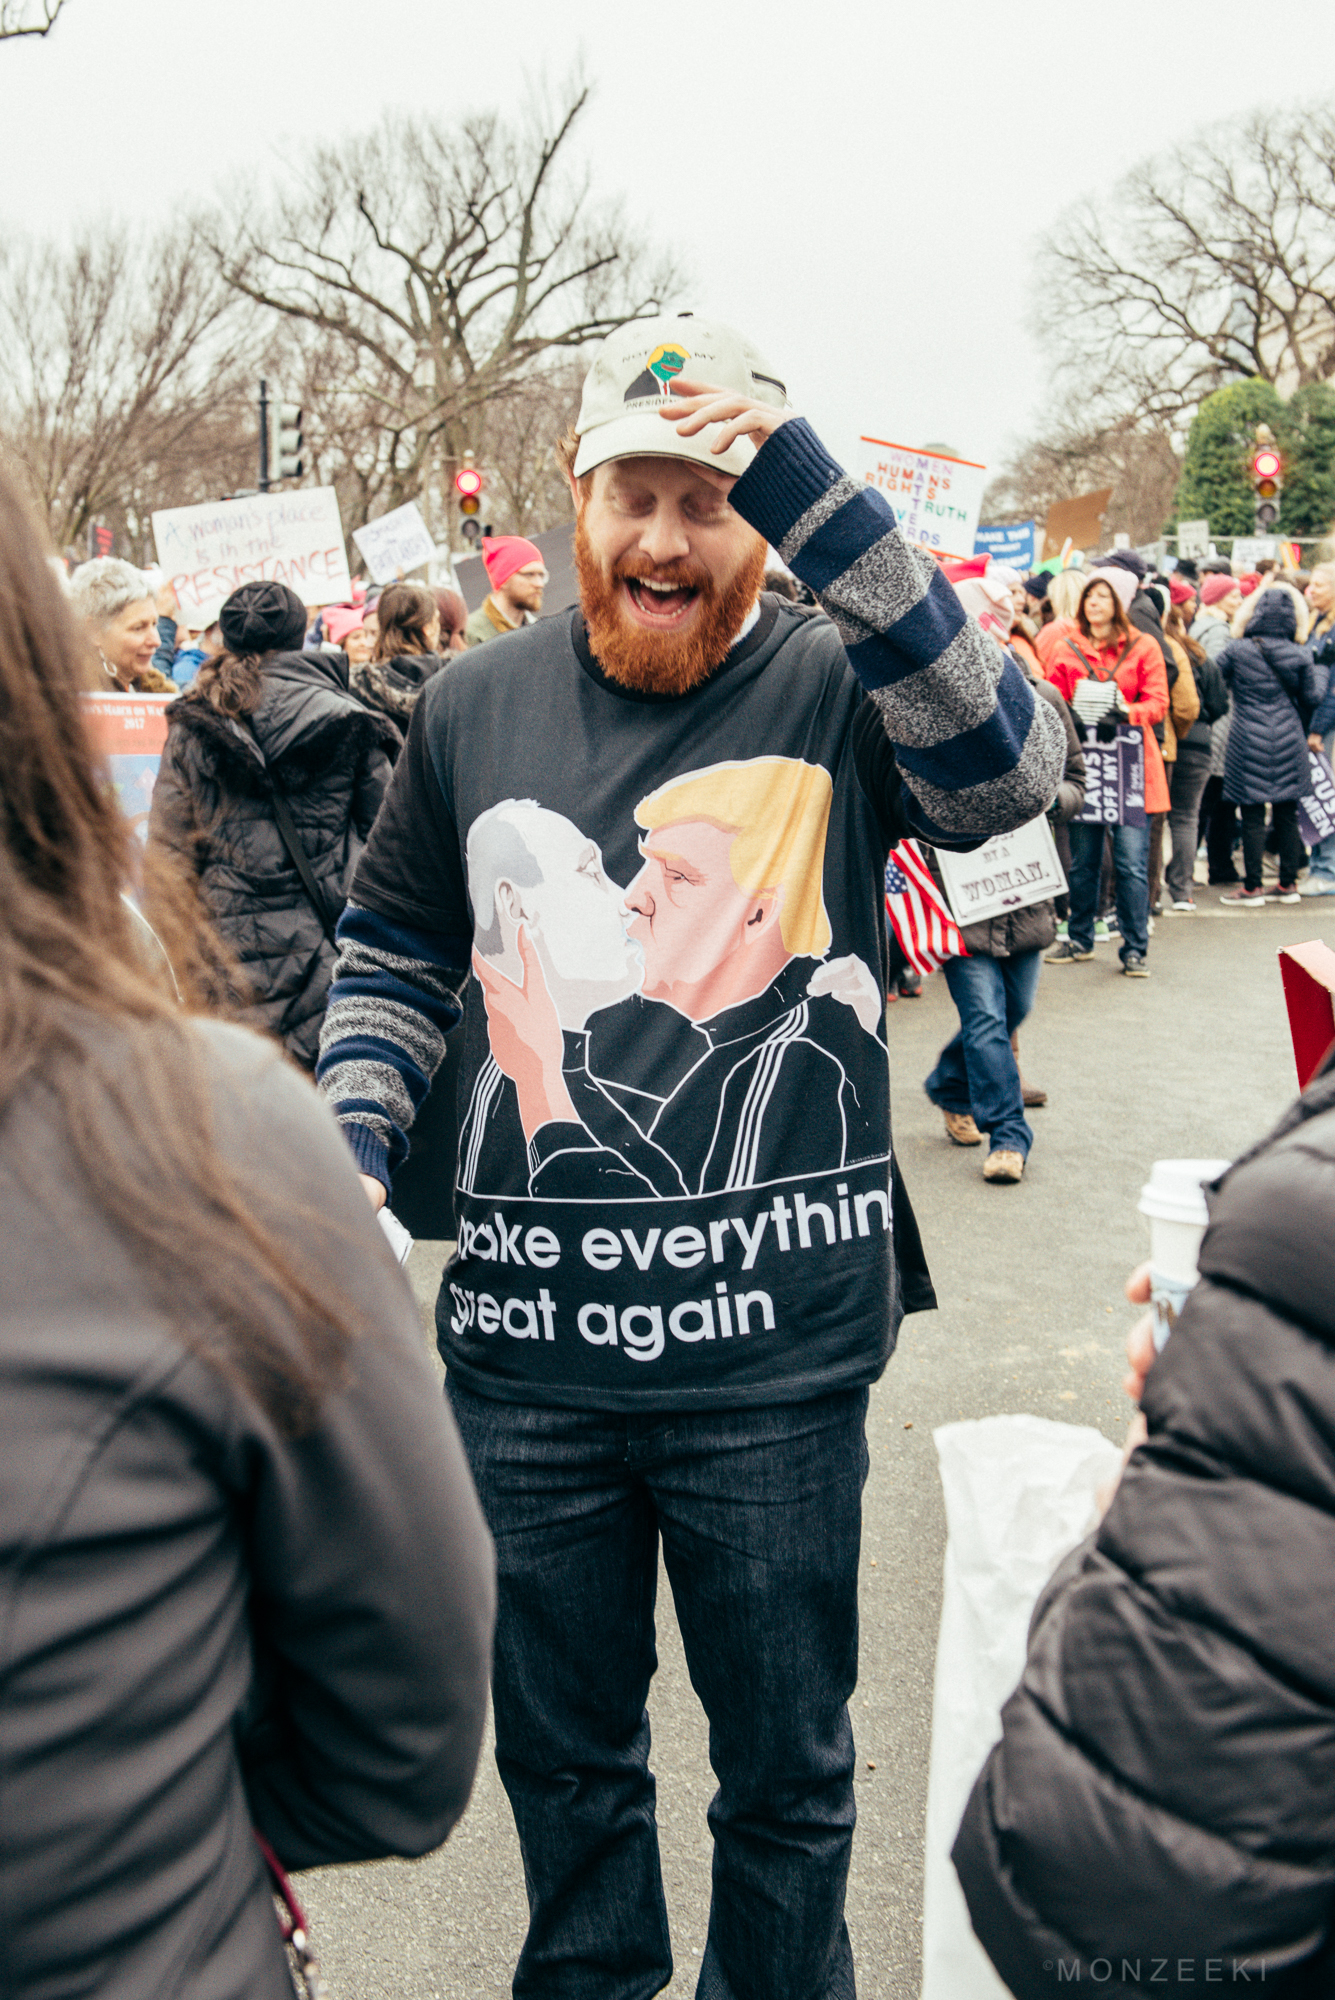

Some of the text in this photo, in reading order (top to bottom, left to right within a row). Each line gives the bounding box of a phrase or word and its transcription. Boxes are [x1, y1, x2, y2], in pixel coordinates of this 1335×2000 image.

[622, 351, 715, 363] NOT MY
[625, 398, 677, 410] PRESIDE
[877, 461, 951, 491] HUMANS
[890, 450, 953, 476] WOMEN
[170, 546, 346, 611] RESISTANCE
[123, 716, 145, 730] 2017
[1081, 751, 1103, 822] LAWS
[1102, 752, 1119, 823] OFF MY
[961, 861, 1050, 901] WOMAN.
[581, 1183, 894, 1271] everythin
[450, 1280, 777, 1362] great again
